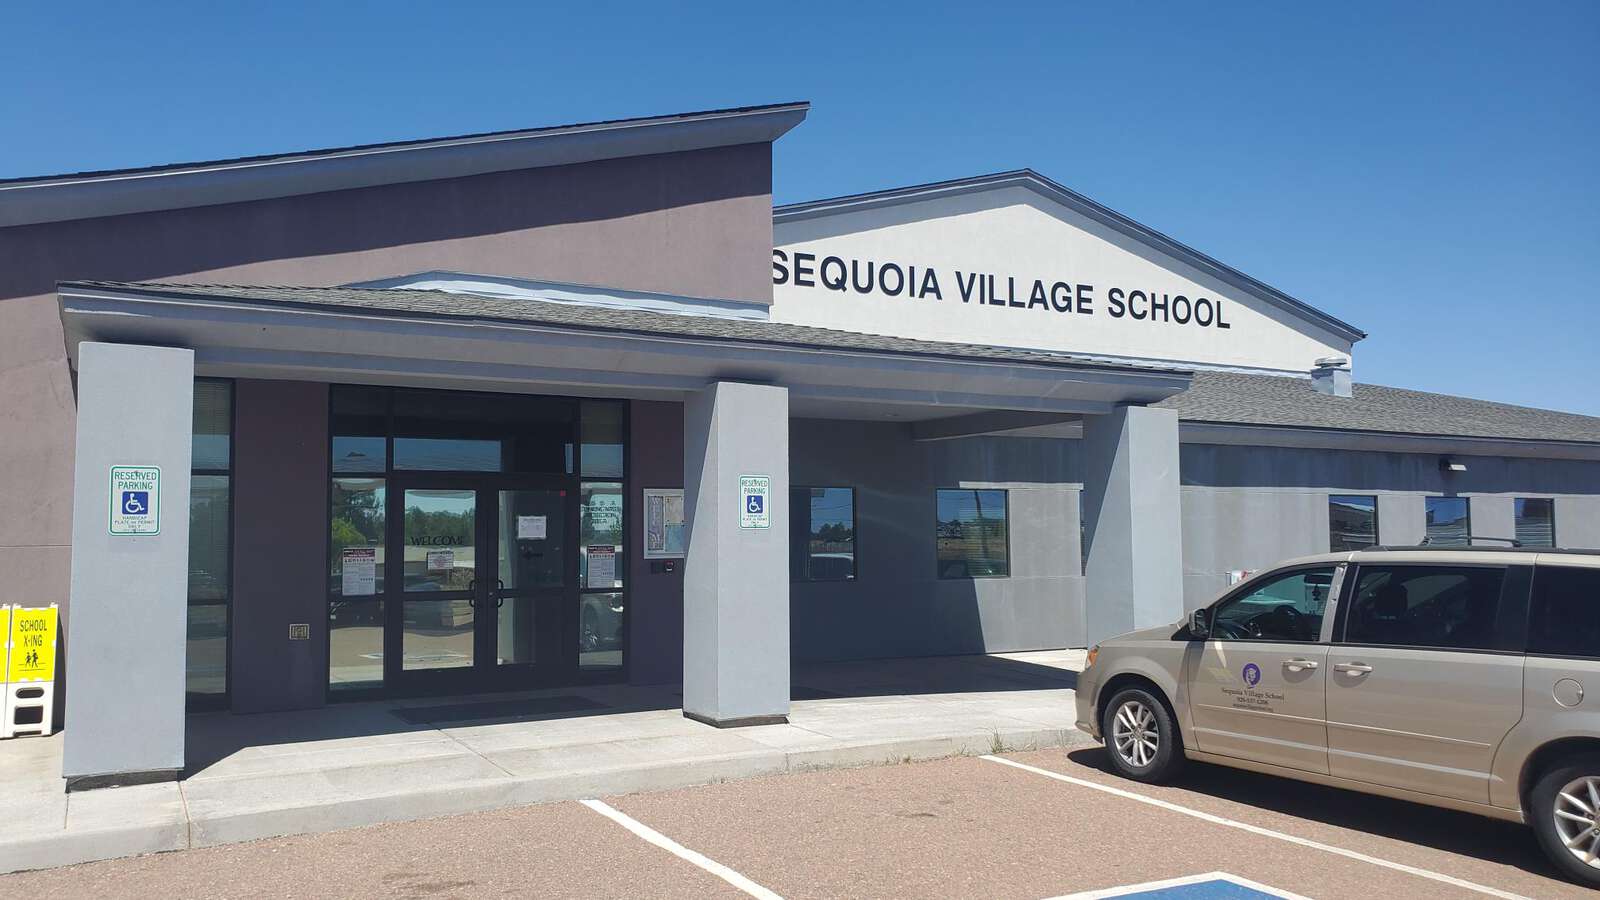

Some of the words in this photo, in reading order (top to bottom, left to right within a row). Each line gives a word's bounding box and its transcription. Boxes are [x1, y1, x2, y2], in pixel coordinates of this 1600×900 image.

[772, 249, 942, 300] SEQUOIA
[955, 271, 1094, 315] VILLAGE
[1107, 287, 1231, 329] SCHOOL
[114, 471, 157, 481] RESERVED
[117, 481, 153, 490] PARKING
[410, 536, 465, 546] WELCOME
[19, 619, 48, 632] SCHOOL
[23, 634, 43, 647] X-ING
[1244, 690, 1264, 698] Village
[1265, 692, 1285, 700] School
